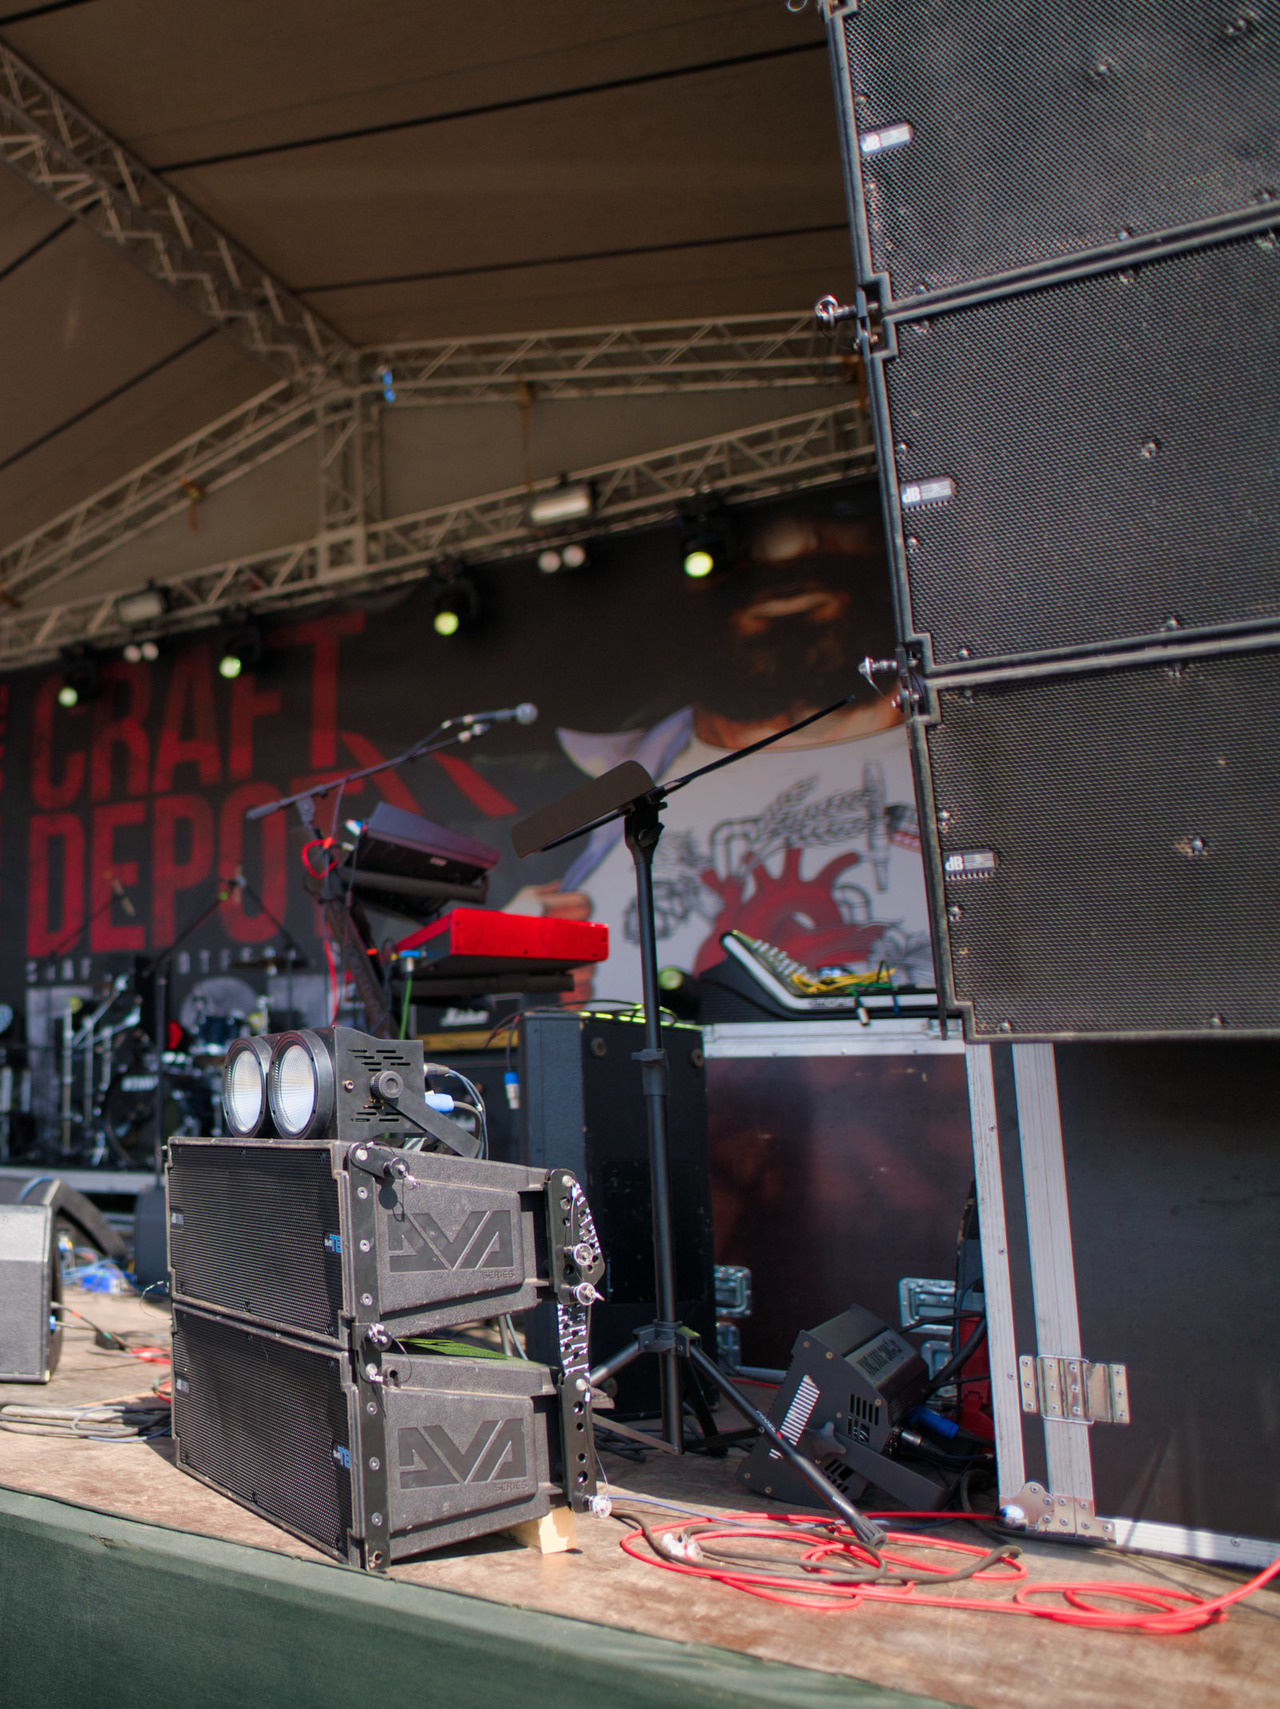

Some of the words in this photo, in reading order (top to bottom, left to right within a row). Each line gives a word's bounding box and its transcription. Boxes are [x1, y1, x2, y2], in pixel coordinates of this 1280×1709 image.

[31, 610, 366, 810] CRAFT
[481, 1270, 516, 1280] SERIES
[495, 1481, 528, 1492] SERIES
